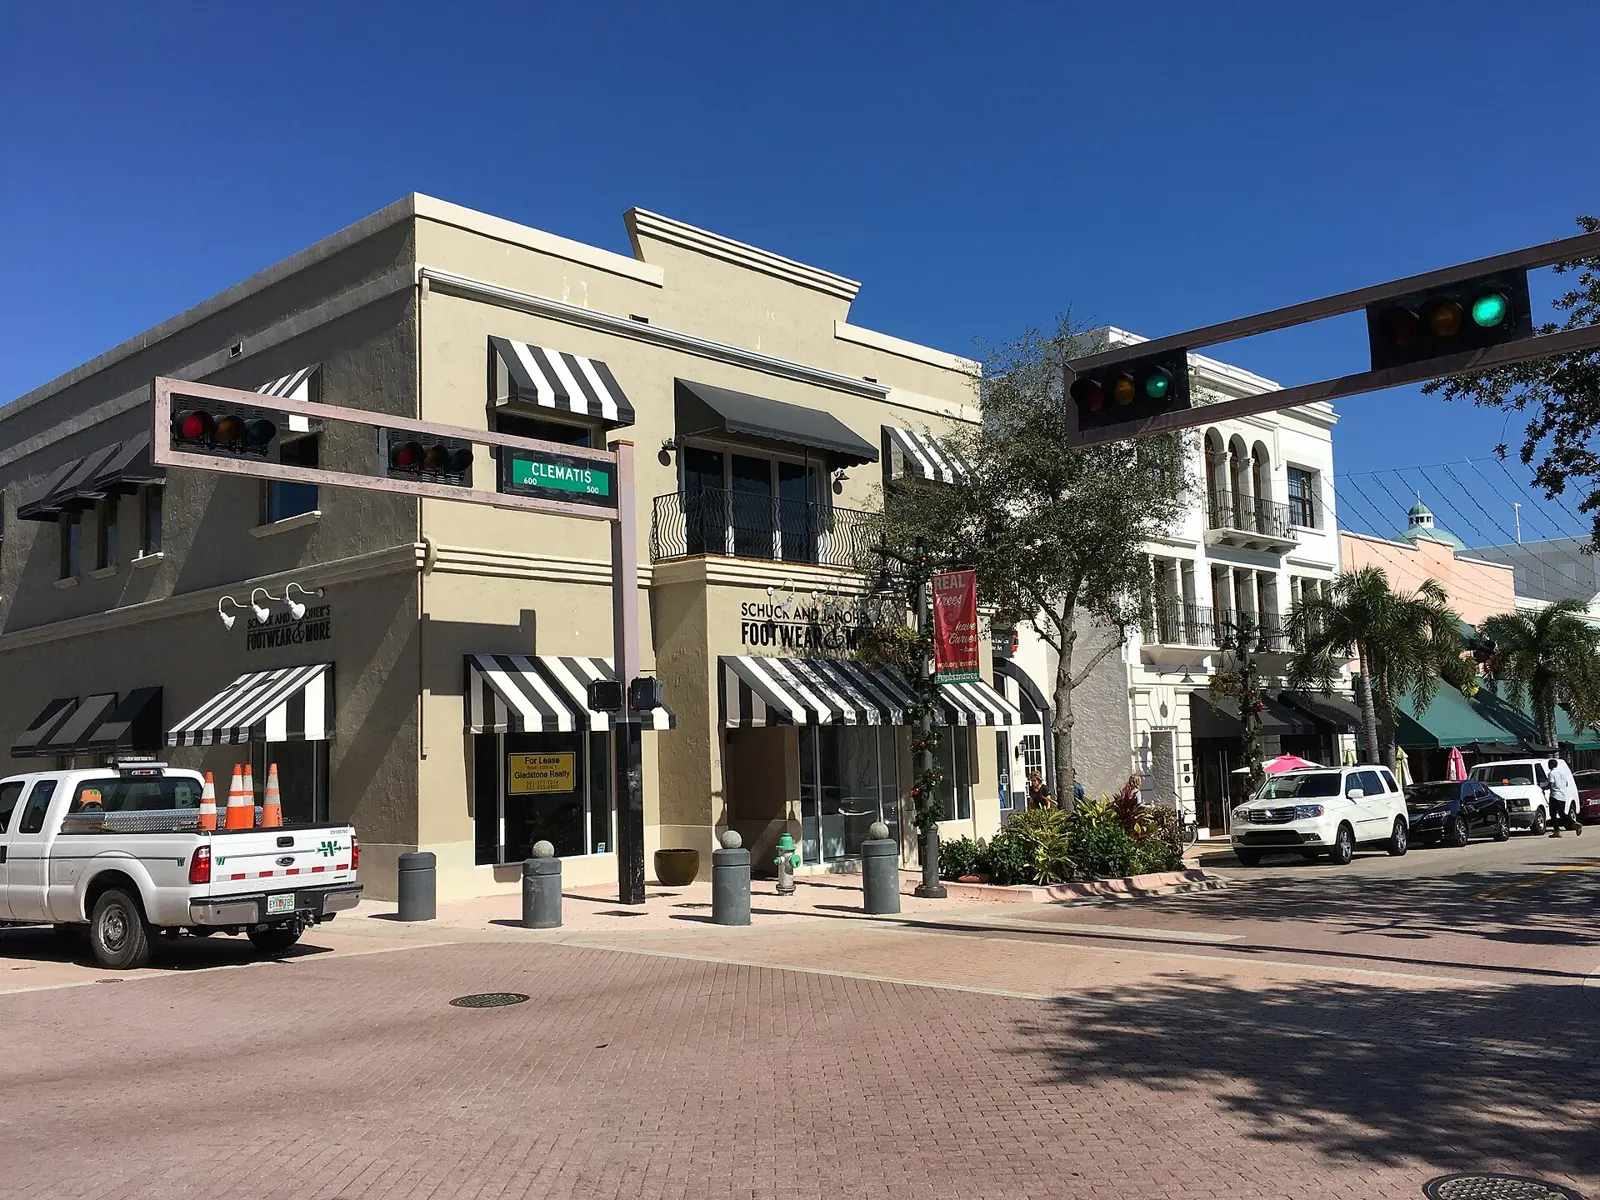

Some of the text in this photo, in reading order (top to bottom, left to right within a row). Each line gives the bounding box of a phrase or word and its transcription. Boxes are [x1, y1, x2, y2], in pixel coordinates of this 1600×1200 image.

[531, 462, 592, 484] CLEMATIS
[523, 477, 537, 486] 600
[586, 486, 599, 494] 500
[933, 574, 966, 591] REAL
[741, 602, 790, 620] SCHUCK
[793, 606, 819, 621] AND
[275, 612, 290, 625] AND
[955, 621, 977, 632] have
[246, 627, 292, 651] FOOTWEAR
[305, 620, 331, 642] MORE
[741, 622, 823, 649] FOOTWEAR
[824, 622, 845, 651] &
[524, 757, 560, 765] For Lease
[514, 770, 571, 779] Gladstone Realty
